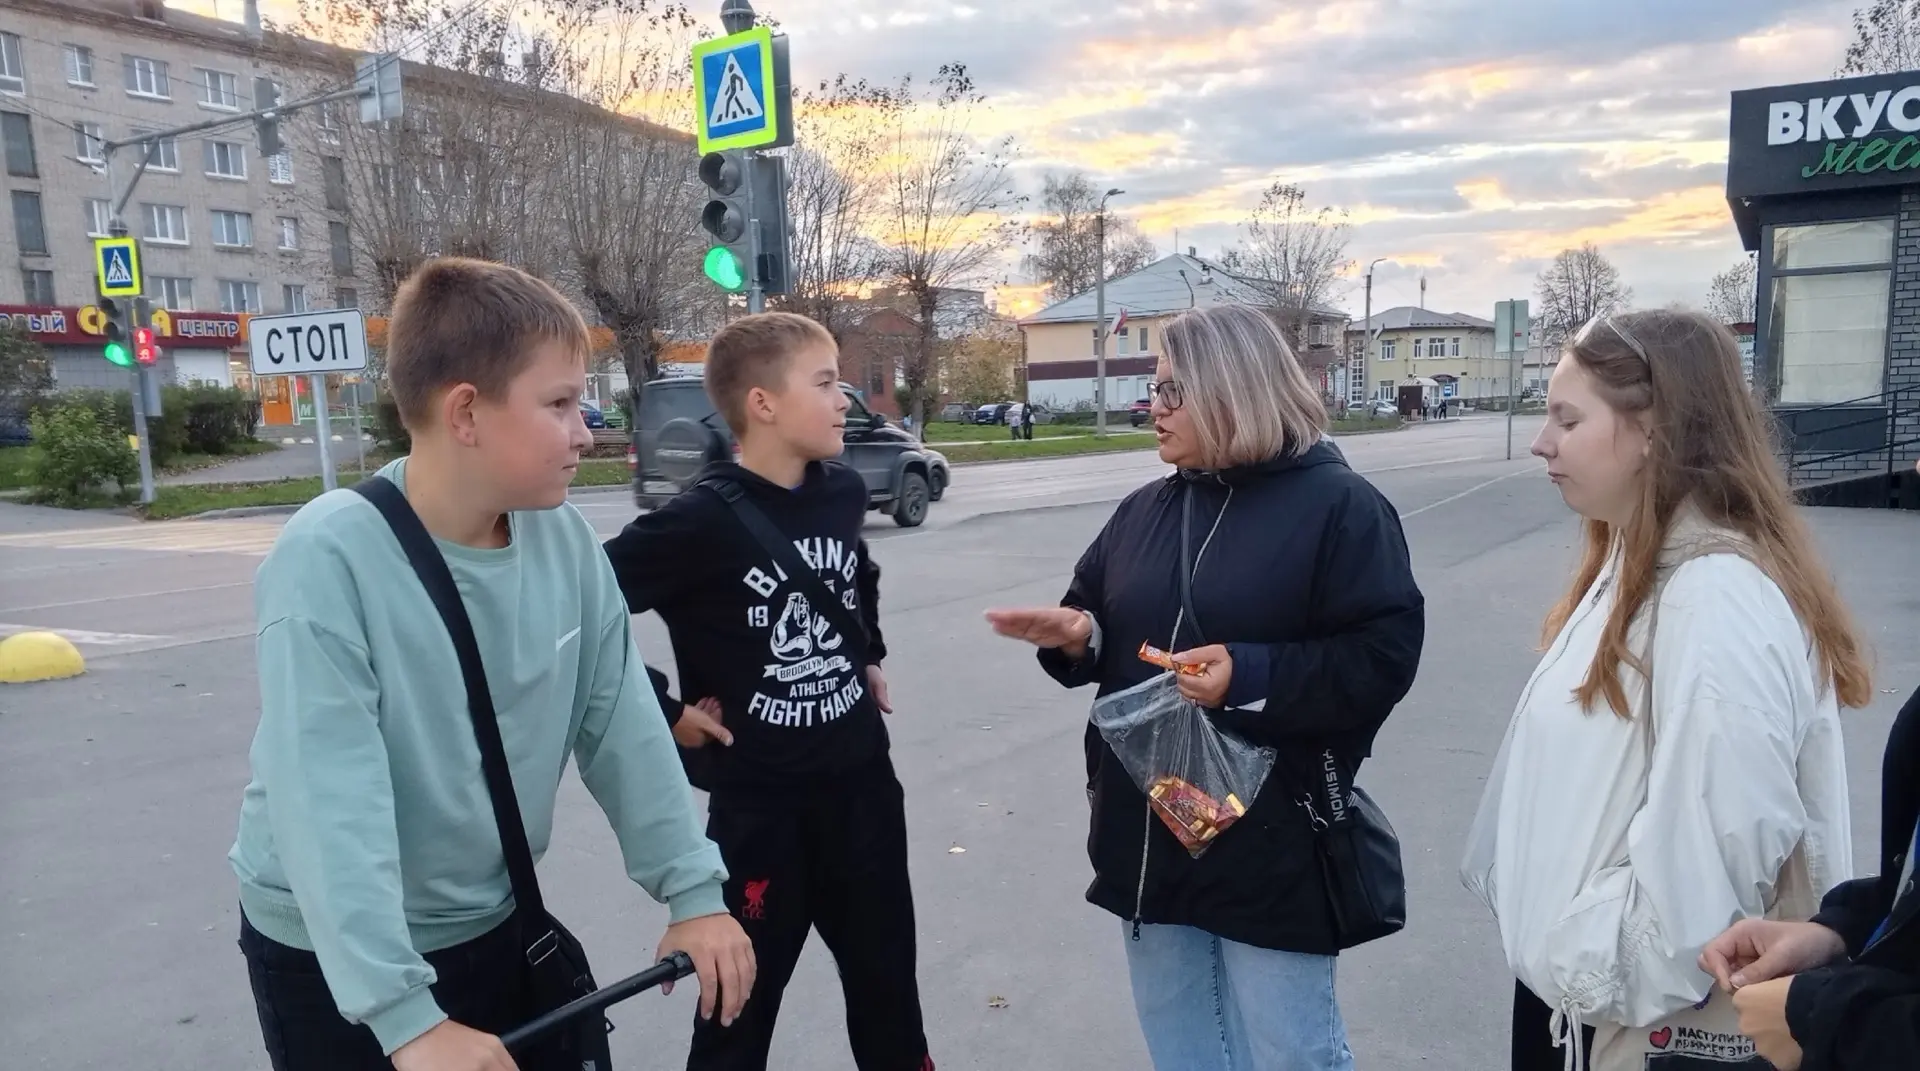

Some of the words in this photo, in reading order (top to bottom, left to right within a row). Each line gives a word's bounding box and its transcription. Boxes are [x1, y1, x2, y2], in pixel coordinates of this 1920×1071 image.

[1768, 85, 1920, 146] ВКУС
[177, 318, 240, 338] ЦЕНТР
[266, 323, 349, 365] СТОП
[747, 605, 769, 627] 19
[780, 658, 822, 679] BROOKLYN
[826, 657, 840, 669] NYC
[747, 691, 817, 727] FIGHT
[820, 674, 864, 724] HARD
[789, 676, 840, 698] ATHLETIC
[1322, 748, 1347, 822] YUSIMON
